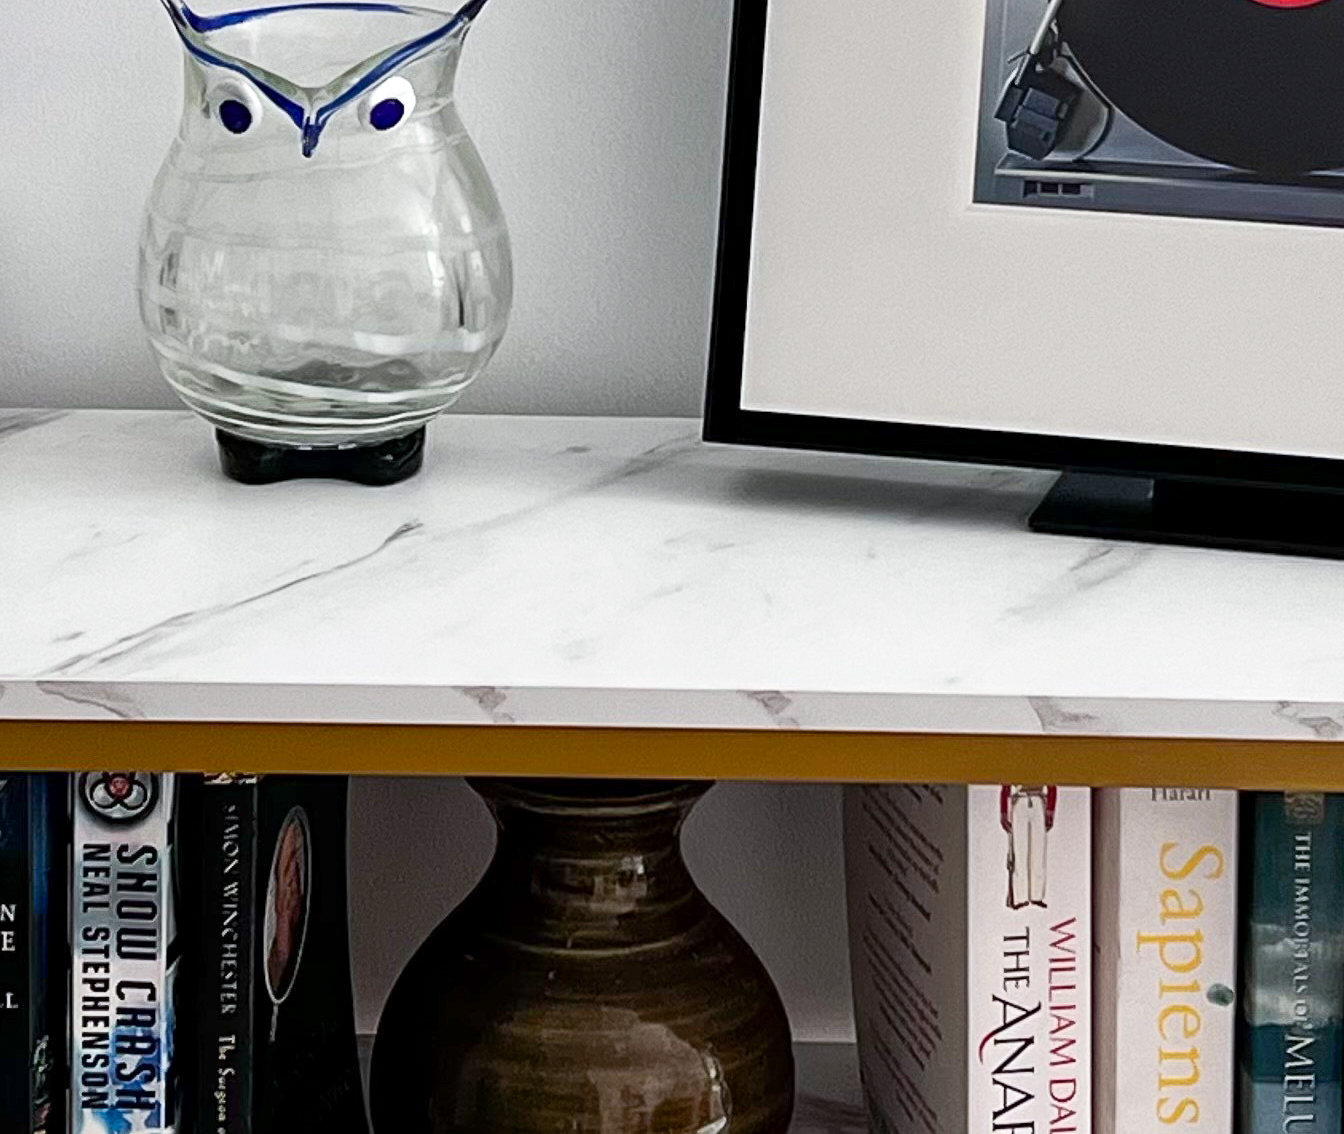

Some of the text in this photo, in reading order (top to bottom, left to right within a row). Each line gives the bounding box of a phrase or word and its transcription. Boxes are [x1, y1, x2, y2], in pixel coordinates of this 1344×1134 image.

[219, 804, 240, 1015] SIMON WINCHESTER
[1294, 831, 1313, 871] THE
[80, 843, 112, 1110] NEAL STEPHENSON
[115, 843, 159, 1111] SNOW CRASH
[1003, 925, 1031, 993] THE
[1048, 916, 1077, 1067] WILLIAM
[1135, 841, 1225, 1125] Sapiens
[1293, 877, 1313, 995] IMMORTALS
[217, 1033, 236, 1061] The
